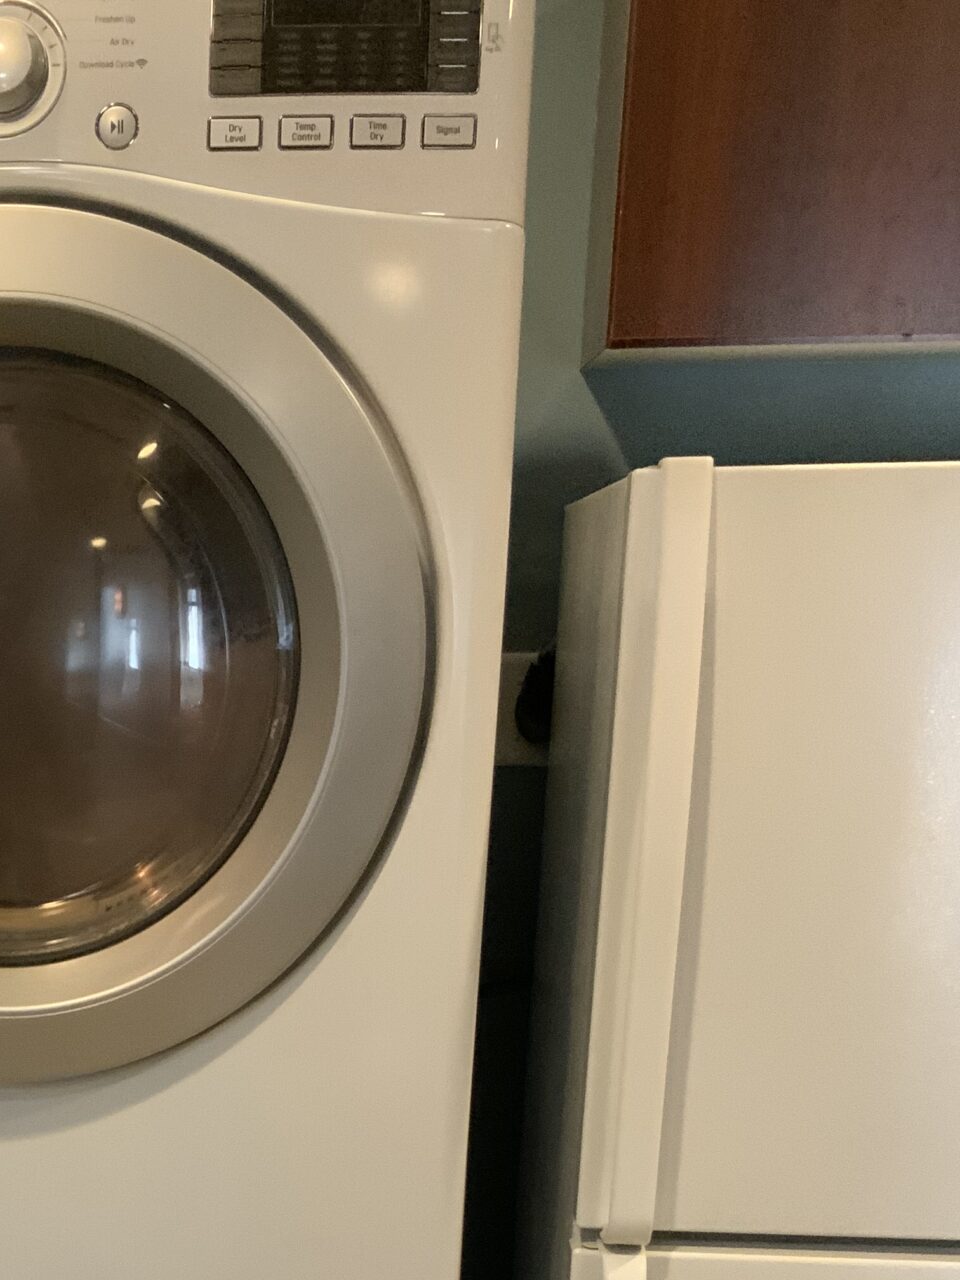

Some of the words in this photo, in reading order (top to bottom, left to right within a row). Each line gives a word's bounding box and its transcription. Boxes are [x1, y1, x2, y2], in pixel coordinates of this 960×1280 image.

[228, 123, 243, 133] Dry
[294, 122, 316, 133] Temp
[368, 120, 388, 131] Time
[436, 124, 461, 136] Signal
[224, 134, 247, 143] Level
[291, 132, 321, 142] Control
[369, 132, 384, 142] Dry
